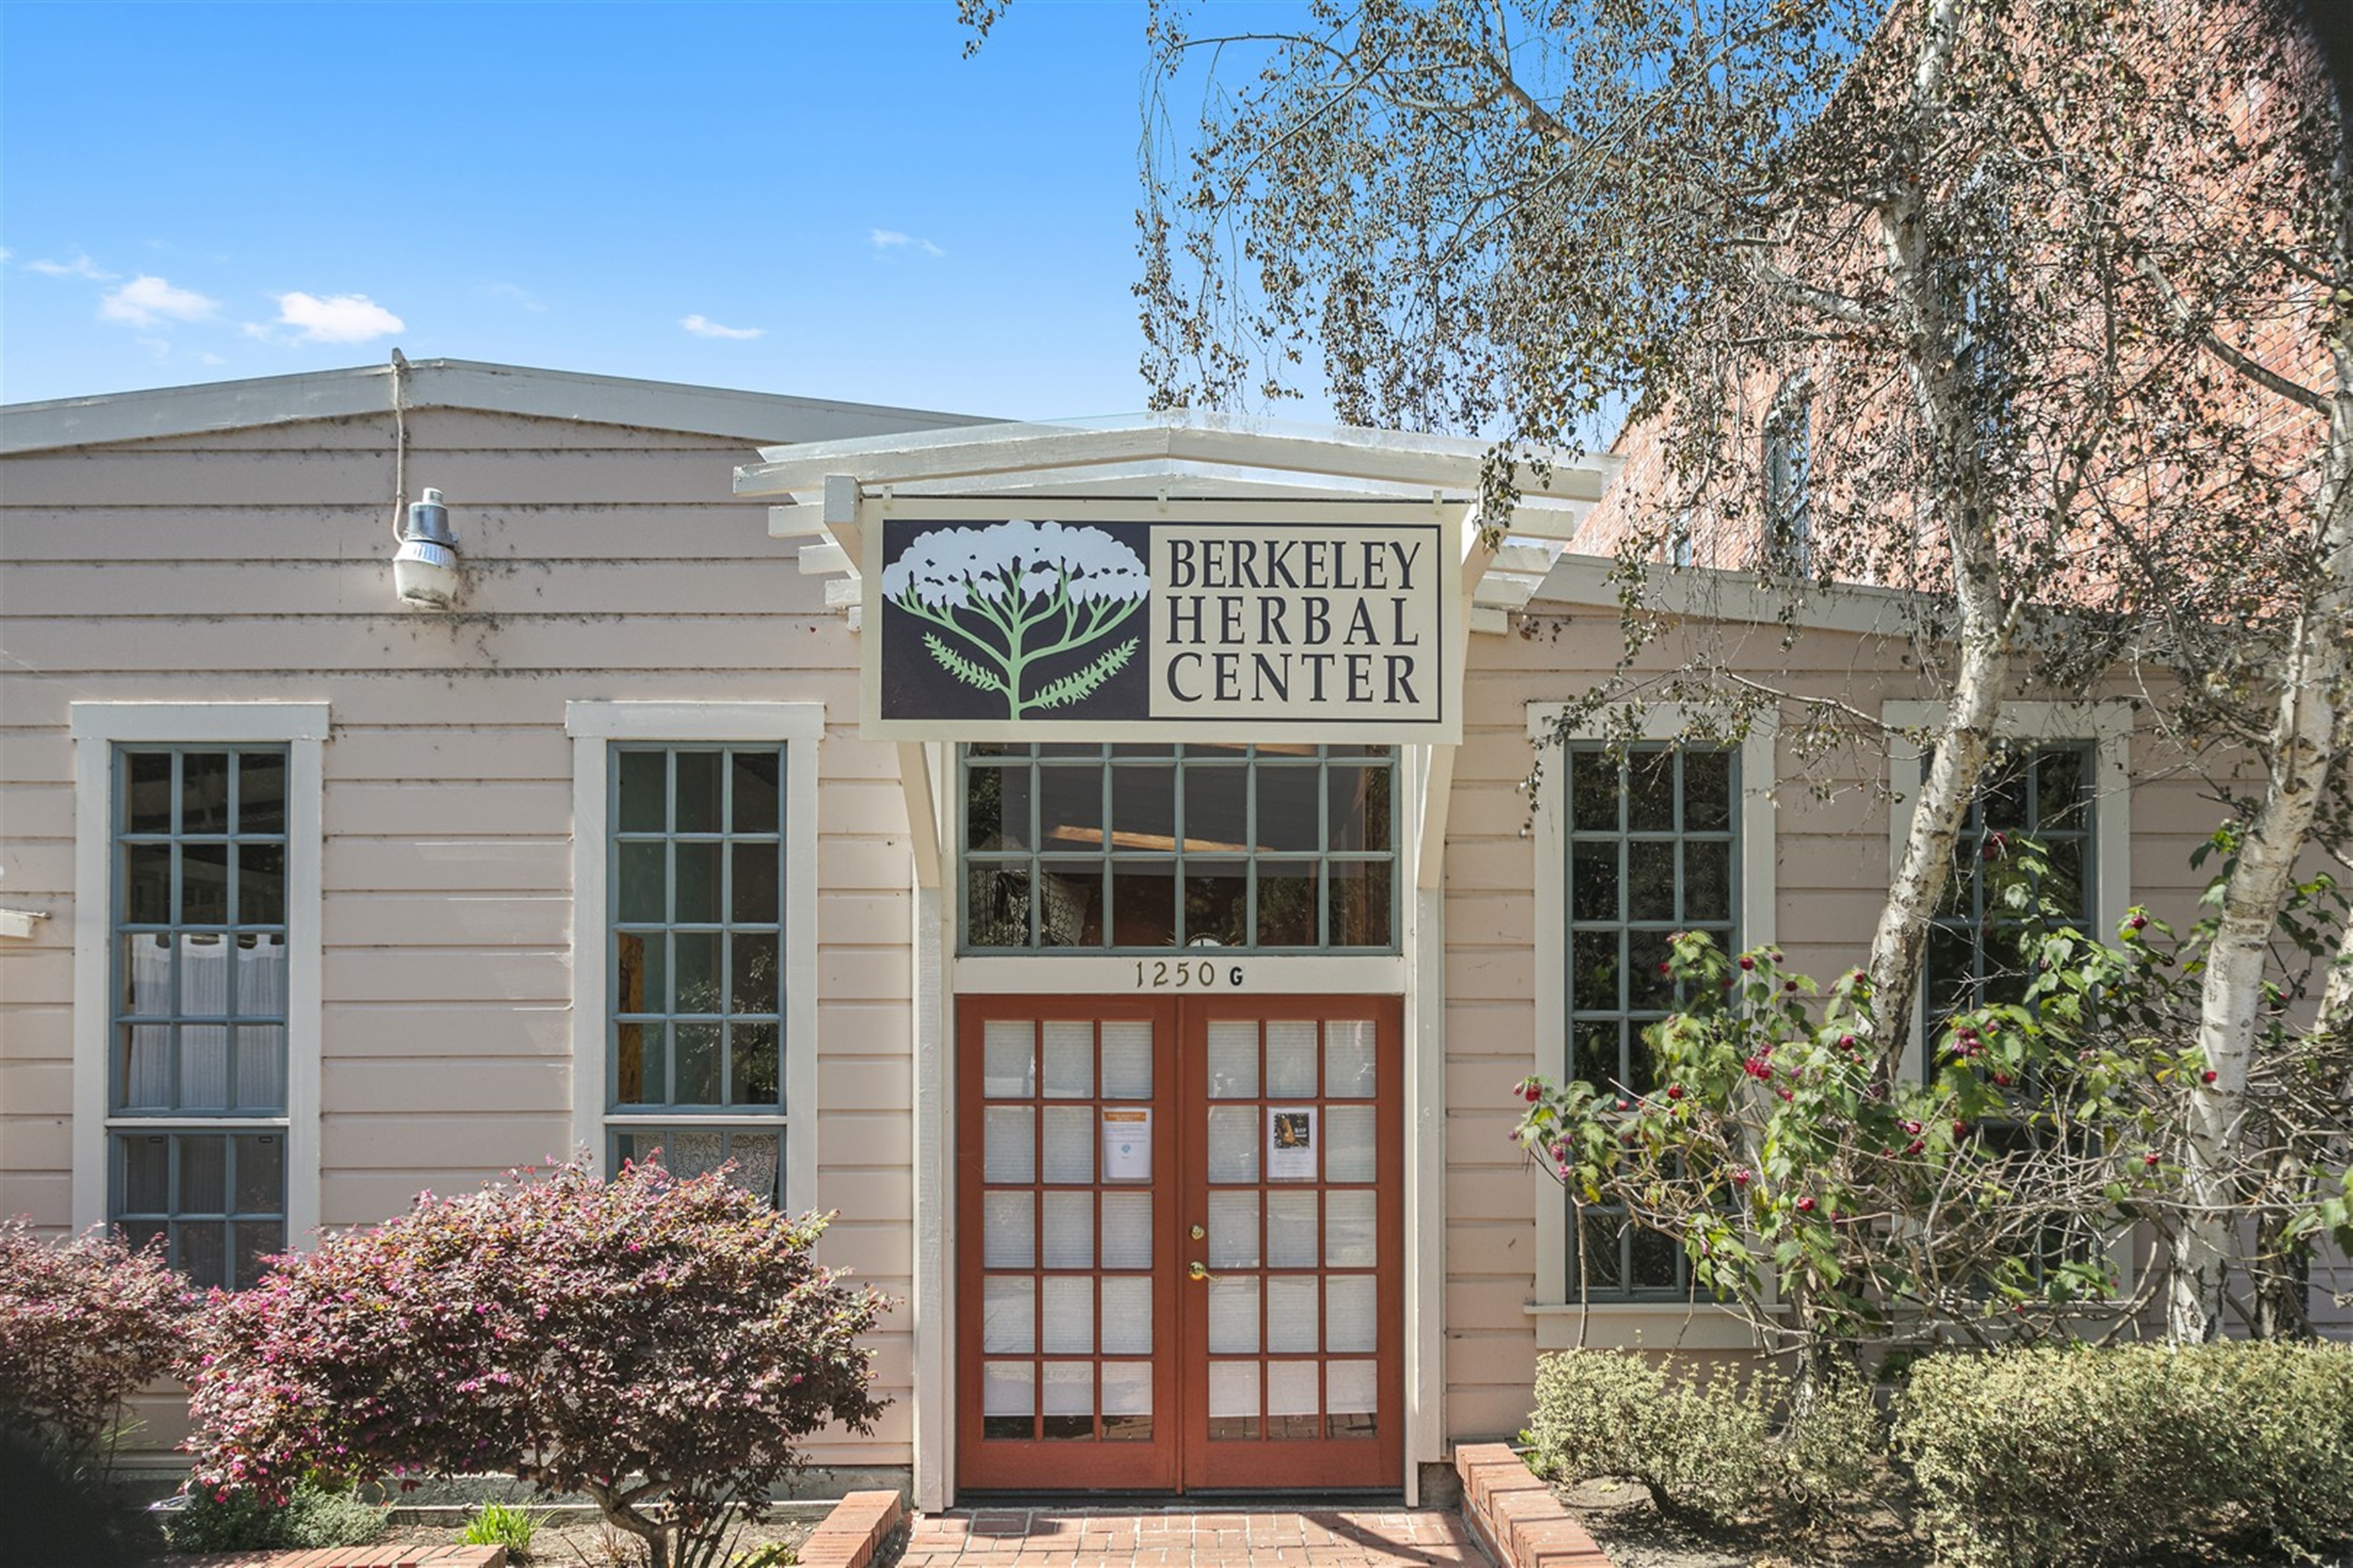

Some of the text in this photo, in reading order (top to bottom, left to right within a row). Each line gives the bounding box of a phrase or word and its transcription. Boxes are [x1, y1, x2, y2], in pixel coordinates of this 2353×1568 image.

[1166, 539, 1421, 589] BERKELEY
[1166, 595, 1419, 646] HERBAL
[1166, 652, 1420, 703] CENTER
[1136, 961, 1243, 988] 1250 G
